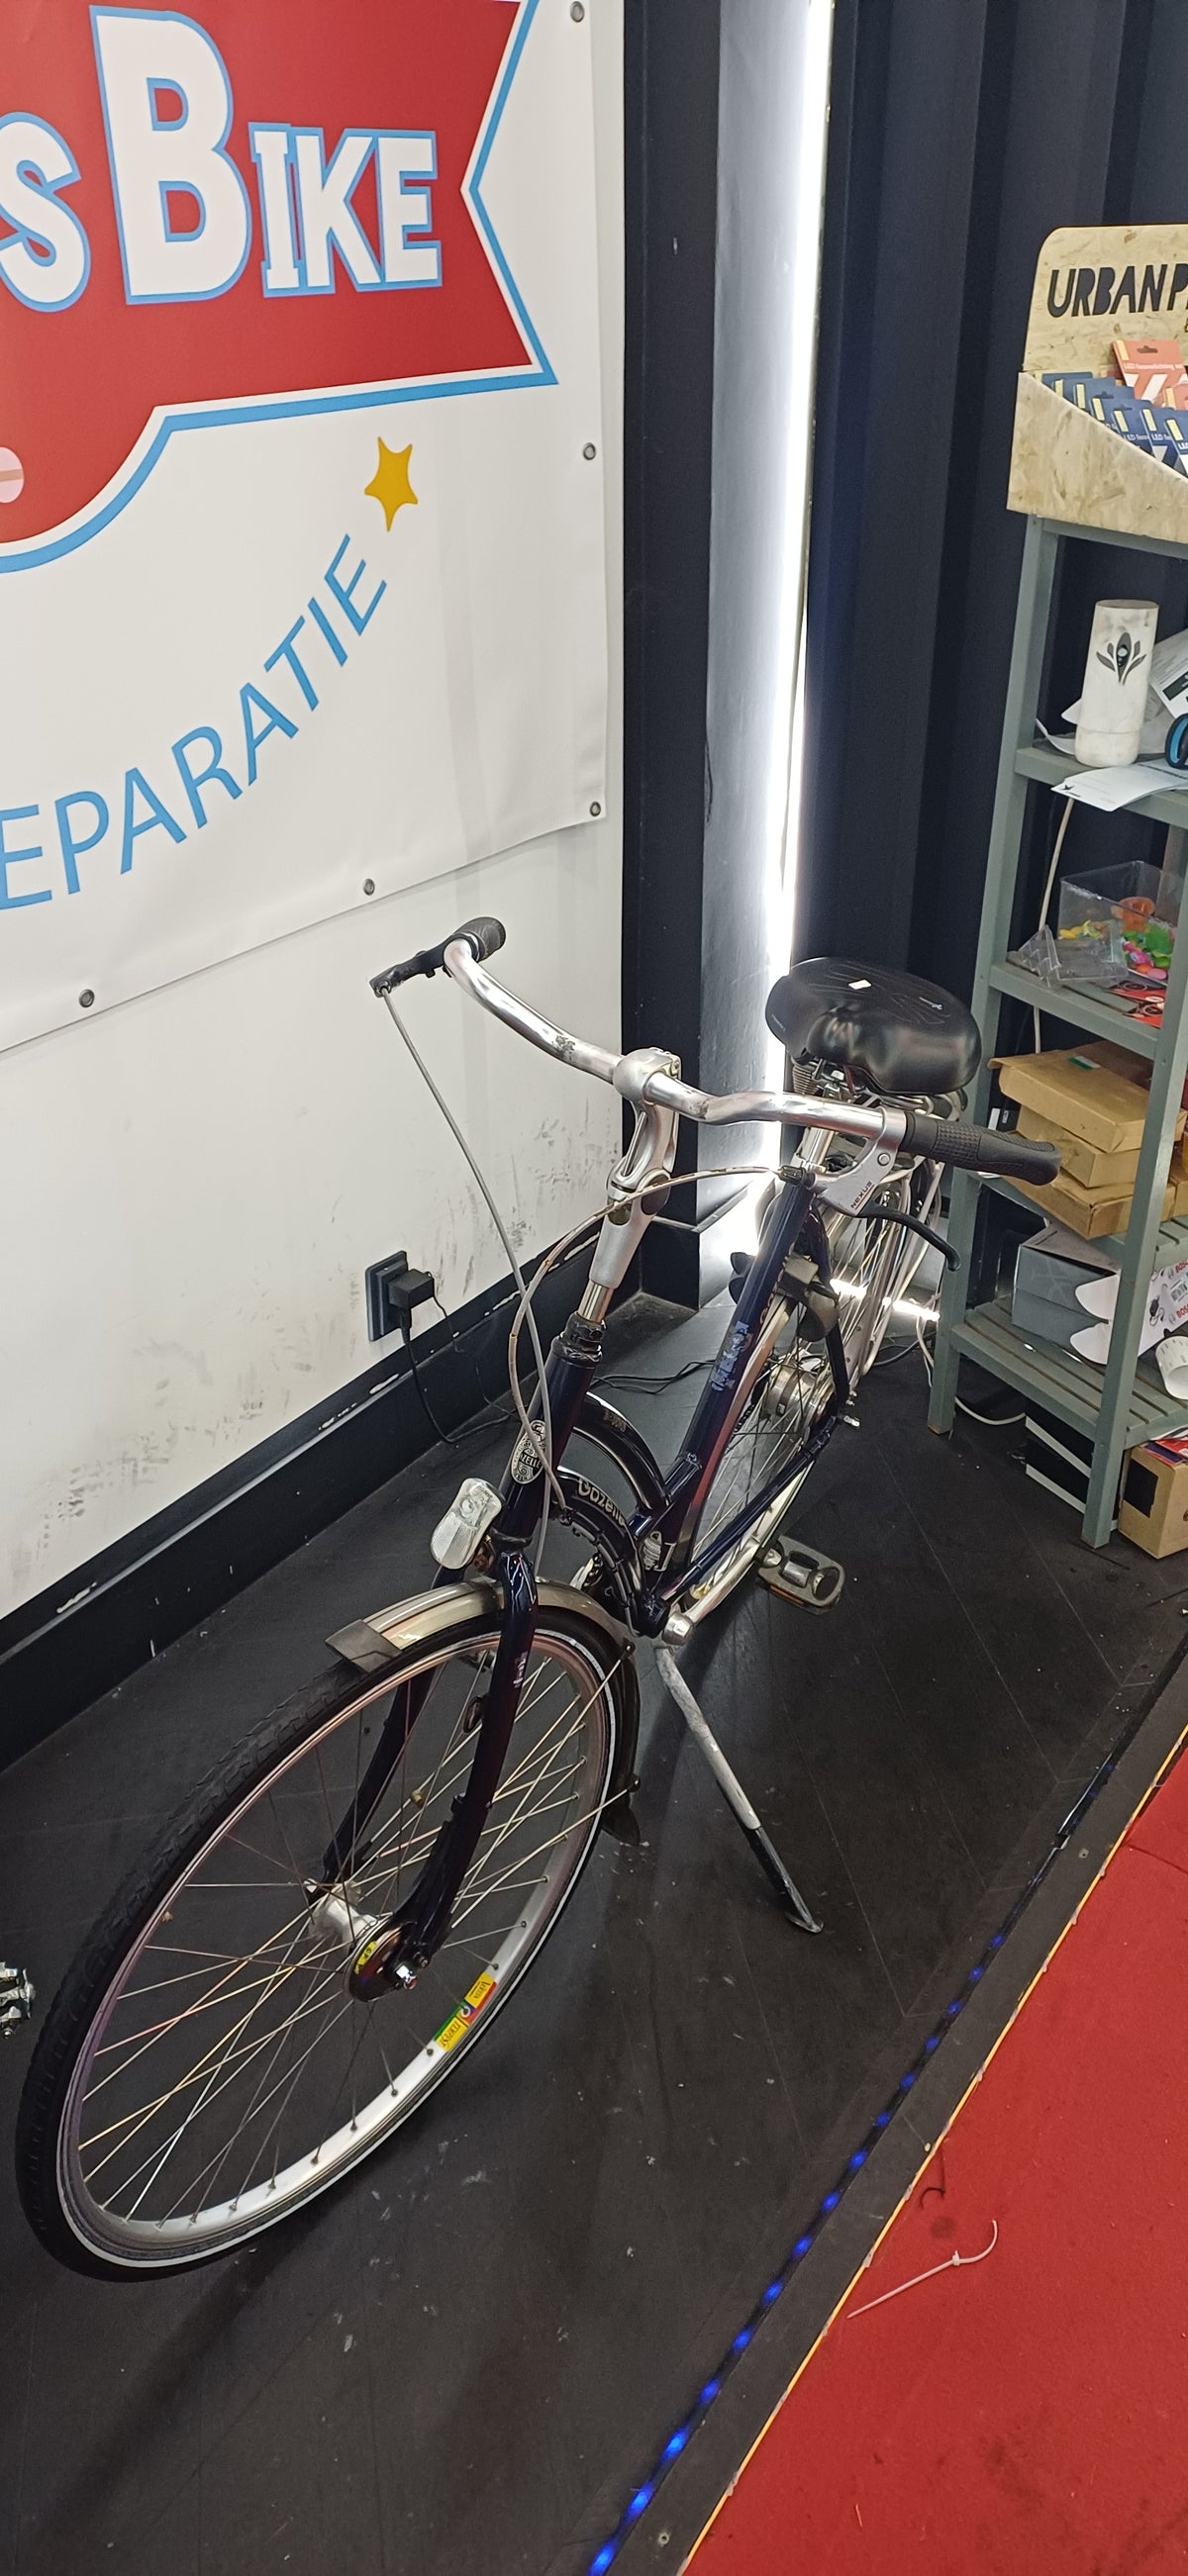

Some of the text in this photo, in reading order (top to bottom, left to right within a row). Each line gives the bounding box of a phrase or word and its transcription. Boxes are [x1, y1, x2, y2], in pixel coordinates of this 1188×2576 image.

[91, 6, 442, 305] BIKE
[1047, 262, 1188, 318] URBAN P
[850, 1180, 873, 1209] NEXUS
